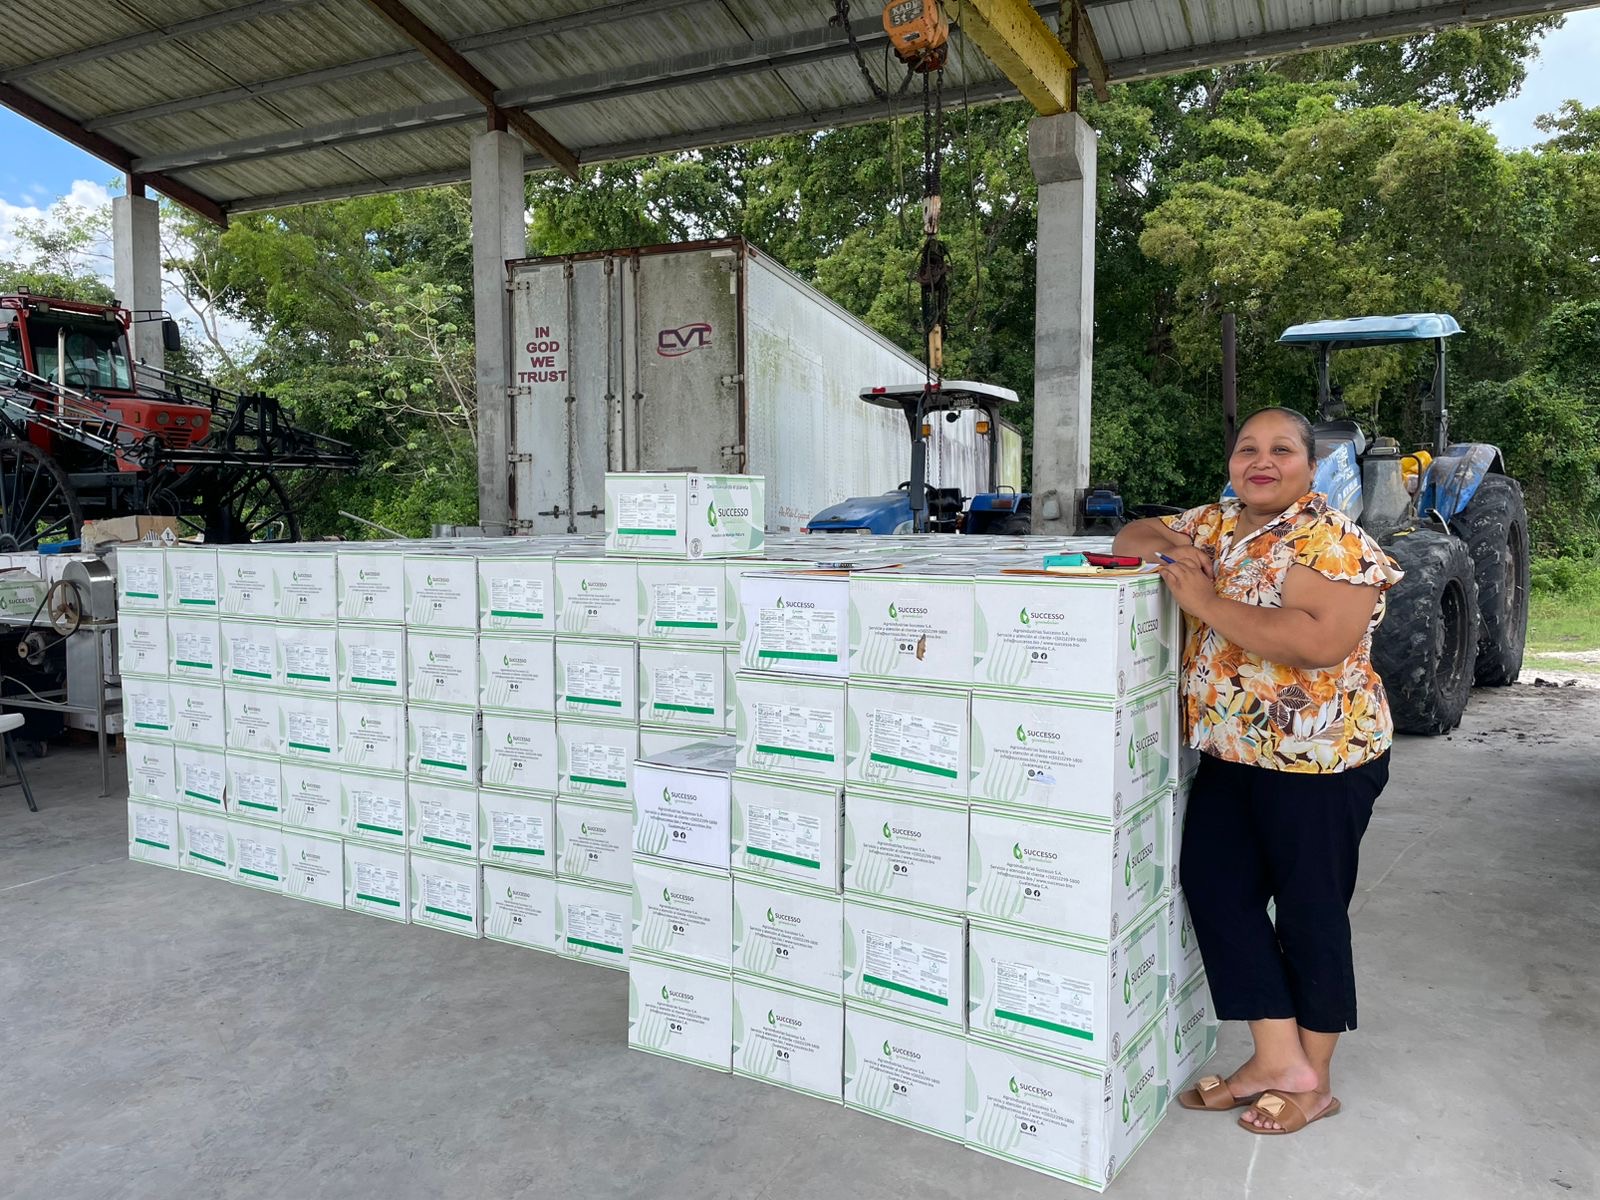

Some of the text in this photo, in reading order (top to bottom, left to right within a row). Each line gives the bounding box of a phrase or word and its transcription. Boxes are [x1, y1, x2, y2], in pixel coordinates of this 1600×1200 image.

[535, 326, 550, 338] IN
[658, 326, 711, 348] CVT
[526, 341, 560, 353] GOD
[531, 356, 555, 368] WE
[518, 370, 567, 383] TRUST
[718, 508, 749, 517] SUCCESSO
[786, 601, 815, 609] SUCCESSO
[1137, 619, 1158, 635] SUCCESSO
[1027, 729, 1060, 739] SUCCESSO
[1136, 731, 1159, 752] SUCCESSO
[671, 791, 697, 800] SUCCESSO
[587, 826, 606, 834] SUCCESSO
[892, 827, 921, 837] SUCCESSO
[1023, 848, 1057, 859] SUCCESSO
[1132, 842, 1154, 869] SUCCESSO
[512, 890, 531, 898] SUCCESSO
[670, 892, 693, 901] SUCCESSO
[775, 912, 800, 923] SUCCESSO
[1131, 954, 1156, 985] SUCCESSO
[669, 990, 693, 1000] SUCCESSO
[776, 1014, 801, 1026] SUCCESSO
[1181, 1007, 1205, 1038] SUCCESSO
[892, 1046, 920, 1059] SUCCESSO
[1019, 1082, 1052, 1097] SUCCESSO
[1130, 1066, 1155, 1103] SUCCESSO
